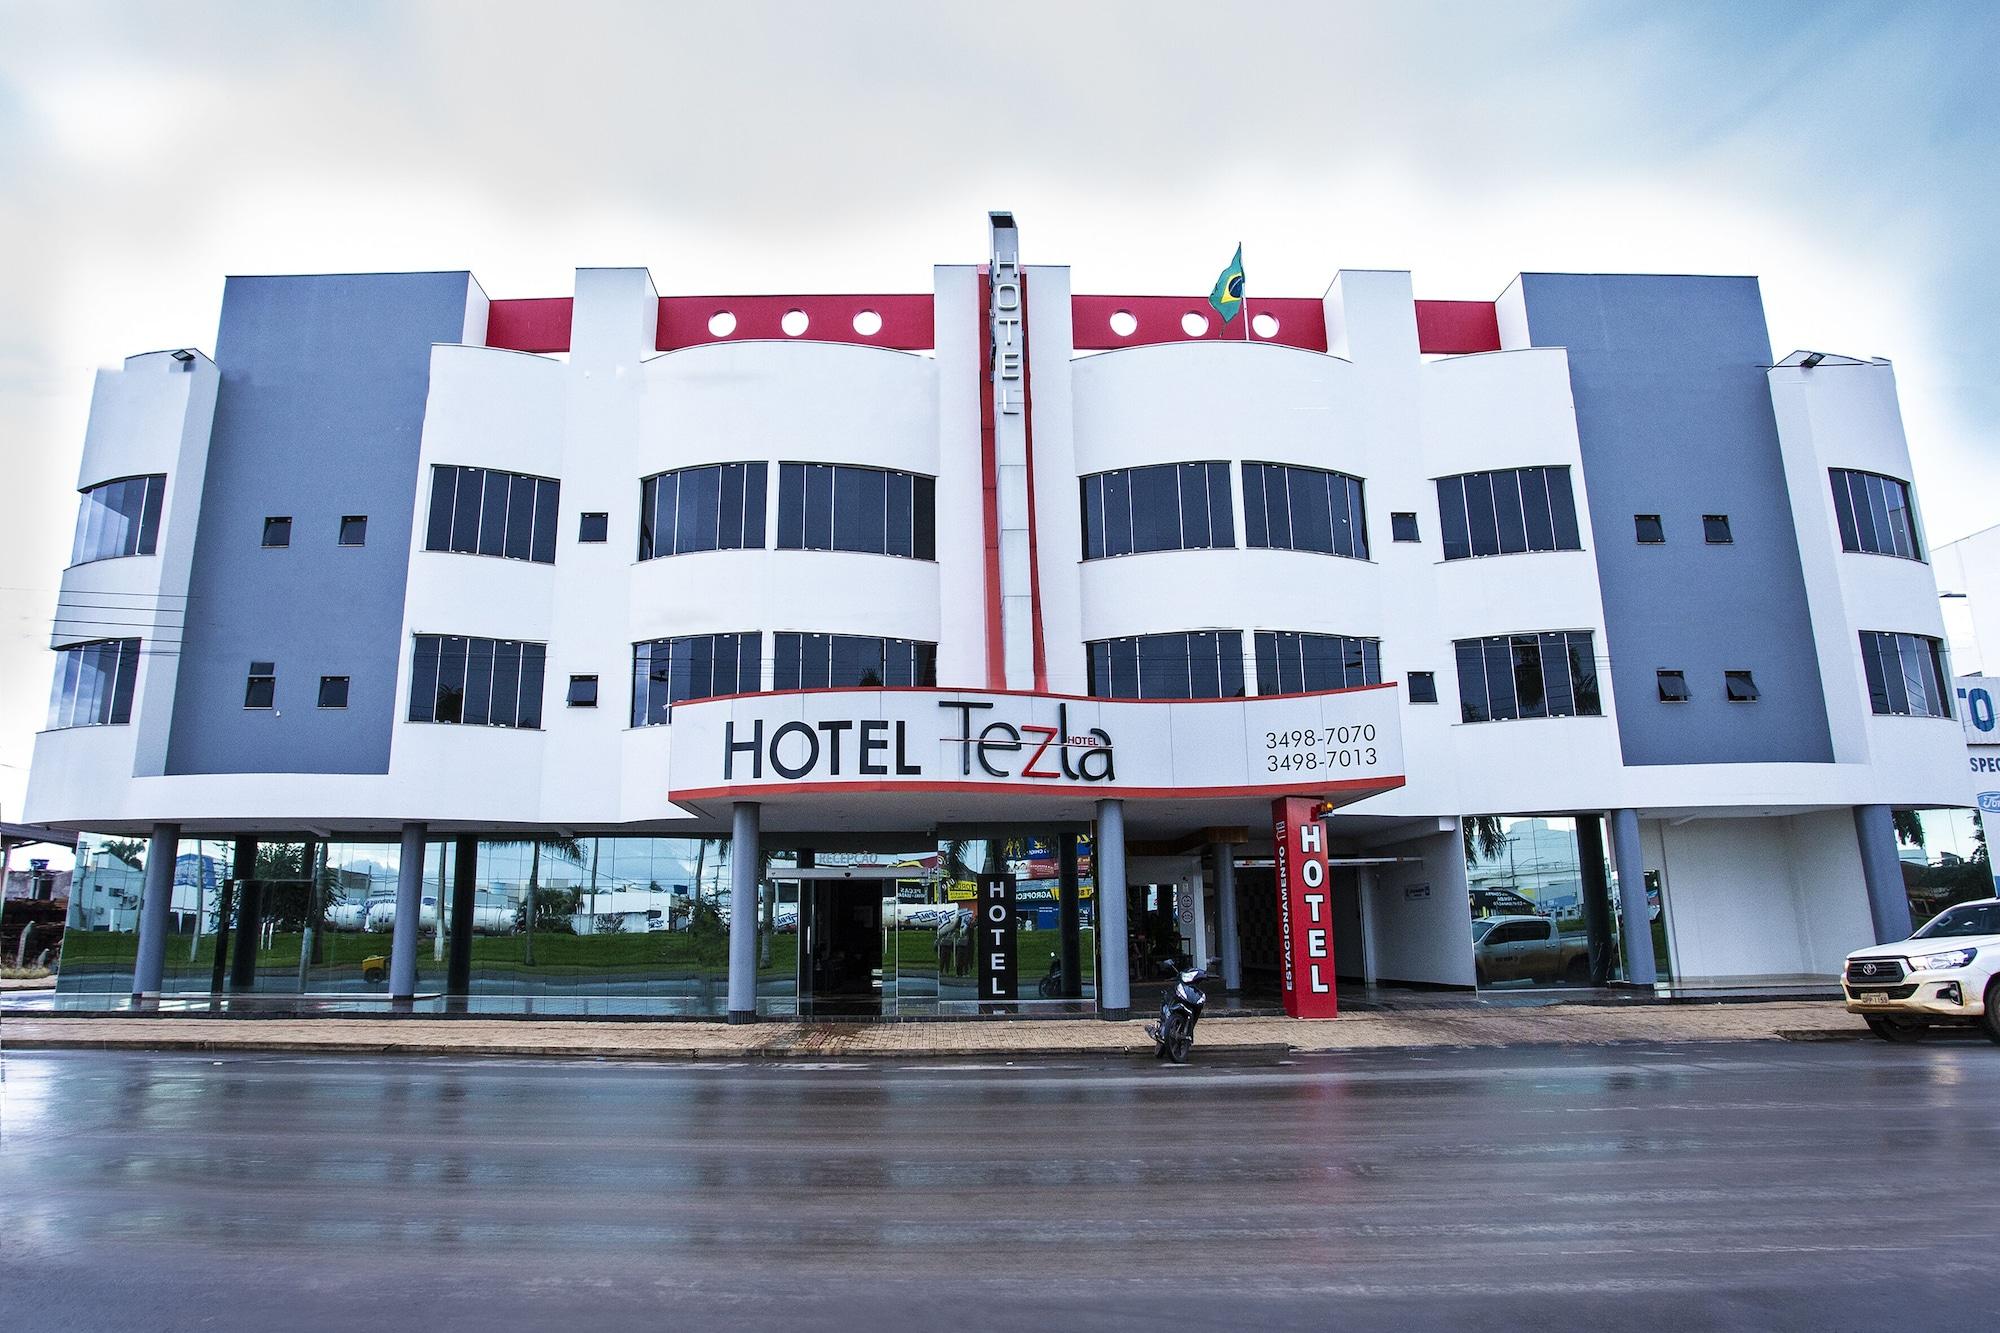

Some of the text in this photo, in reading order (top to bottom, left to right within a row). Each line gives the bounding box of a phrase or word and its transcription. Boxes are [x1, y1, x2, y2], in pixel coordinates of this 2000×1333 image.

[997, 251, 1020, 415] HOTEL
[724, 701, 1115, 781] HOTEL Tezla
[1067, 736, 1099, 746] HOTEL
[1266, 724, 1376, 749] 3498-7070
[1267, 747, 1377, 772] 3498-7013
[988, 881, 1007, 995] HOTEL
[1278, 846, 1293, 991] ESTACIONAMENTO
[1300, 825, 1329, 993] HOTEL
